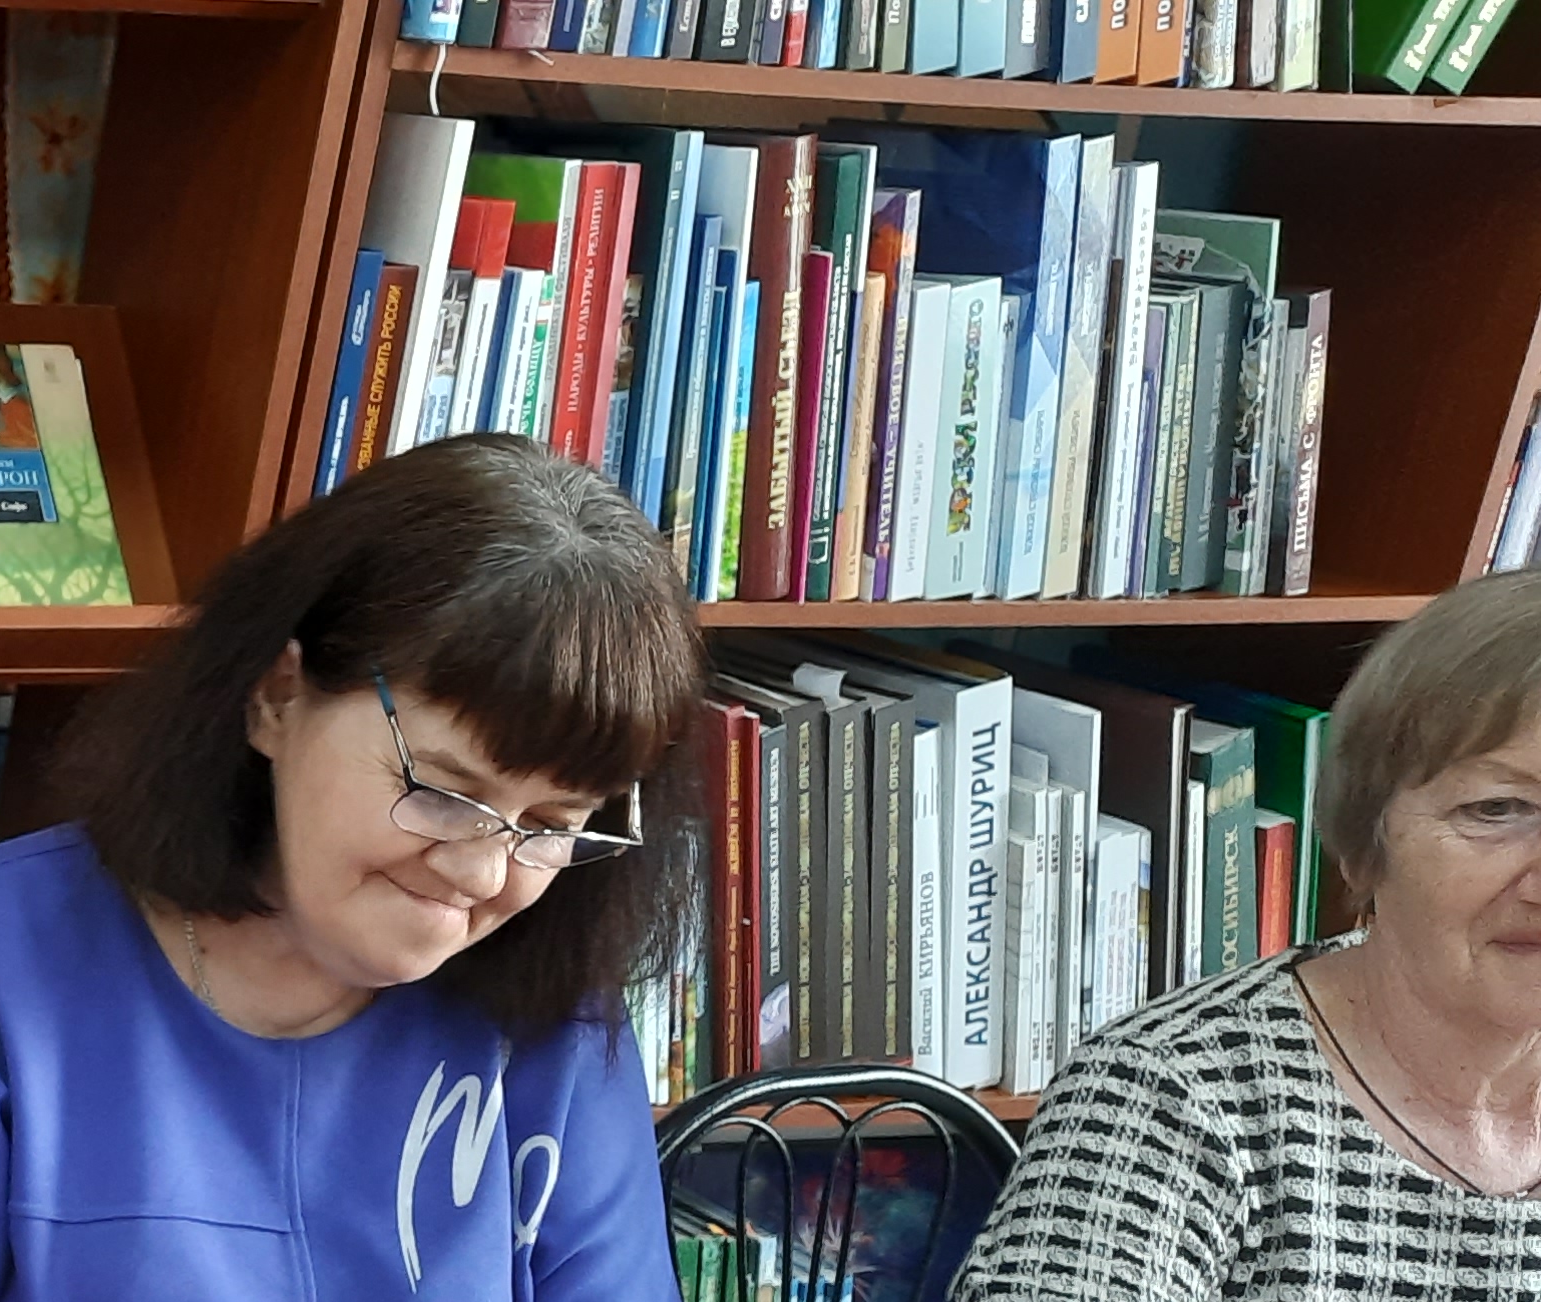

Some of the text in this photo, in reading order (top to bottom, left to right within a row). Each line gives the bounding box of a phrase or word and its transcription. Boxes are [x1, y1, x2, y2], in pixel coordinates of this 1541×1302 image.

[369, 341, 392, 402] СЛУЖИТЬ
[381, 284, 402, 339] РОССИИ
[567, 189, 604, 412] НАРОДЫ КУЛЬТУРЫ РЕЛИГИИ
[891, 318, 907, 366] ИМЯ
[768, 290, 800, 530] ЗАБЫТЫЙ СЪЕЗД
[877, 445, 898, 542] УЧИТЕЛЬ
[1295, 334, 1323, 552] ПИСЬМА С ФРОНТА
[917, 870, 934, 1056] Василий КИРЬЯНОВ
[964, 721, 1001, 1046] АЛЕКСАНДР ШУРИЦ
[1218, 822, 1240, 971] ОСИБИРСК
